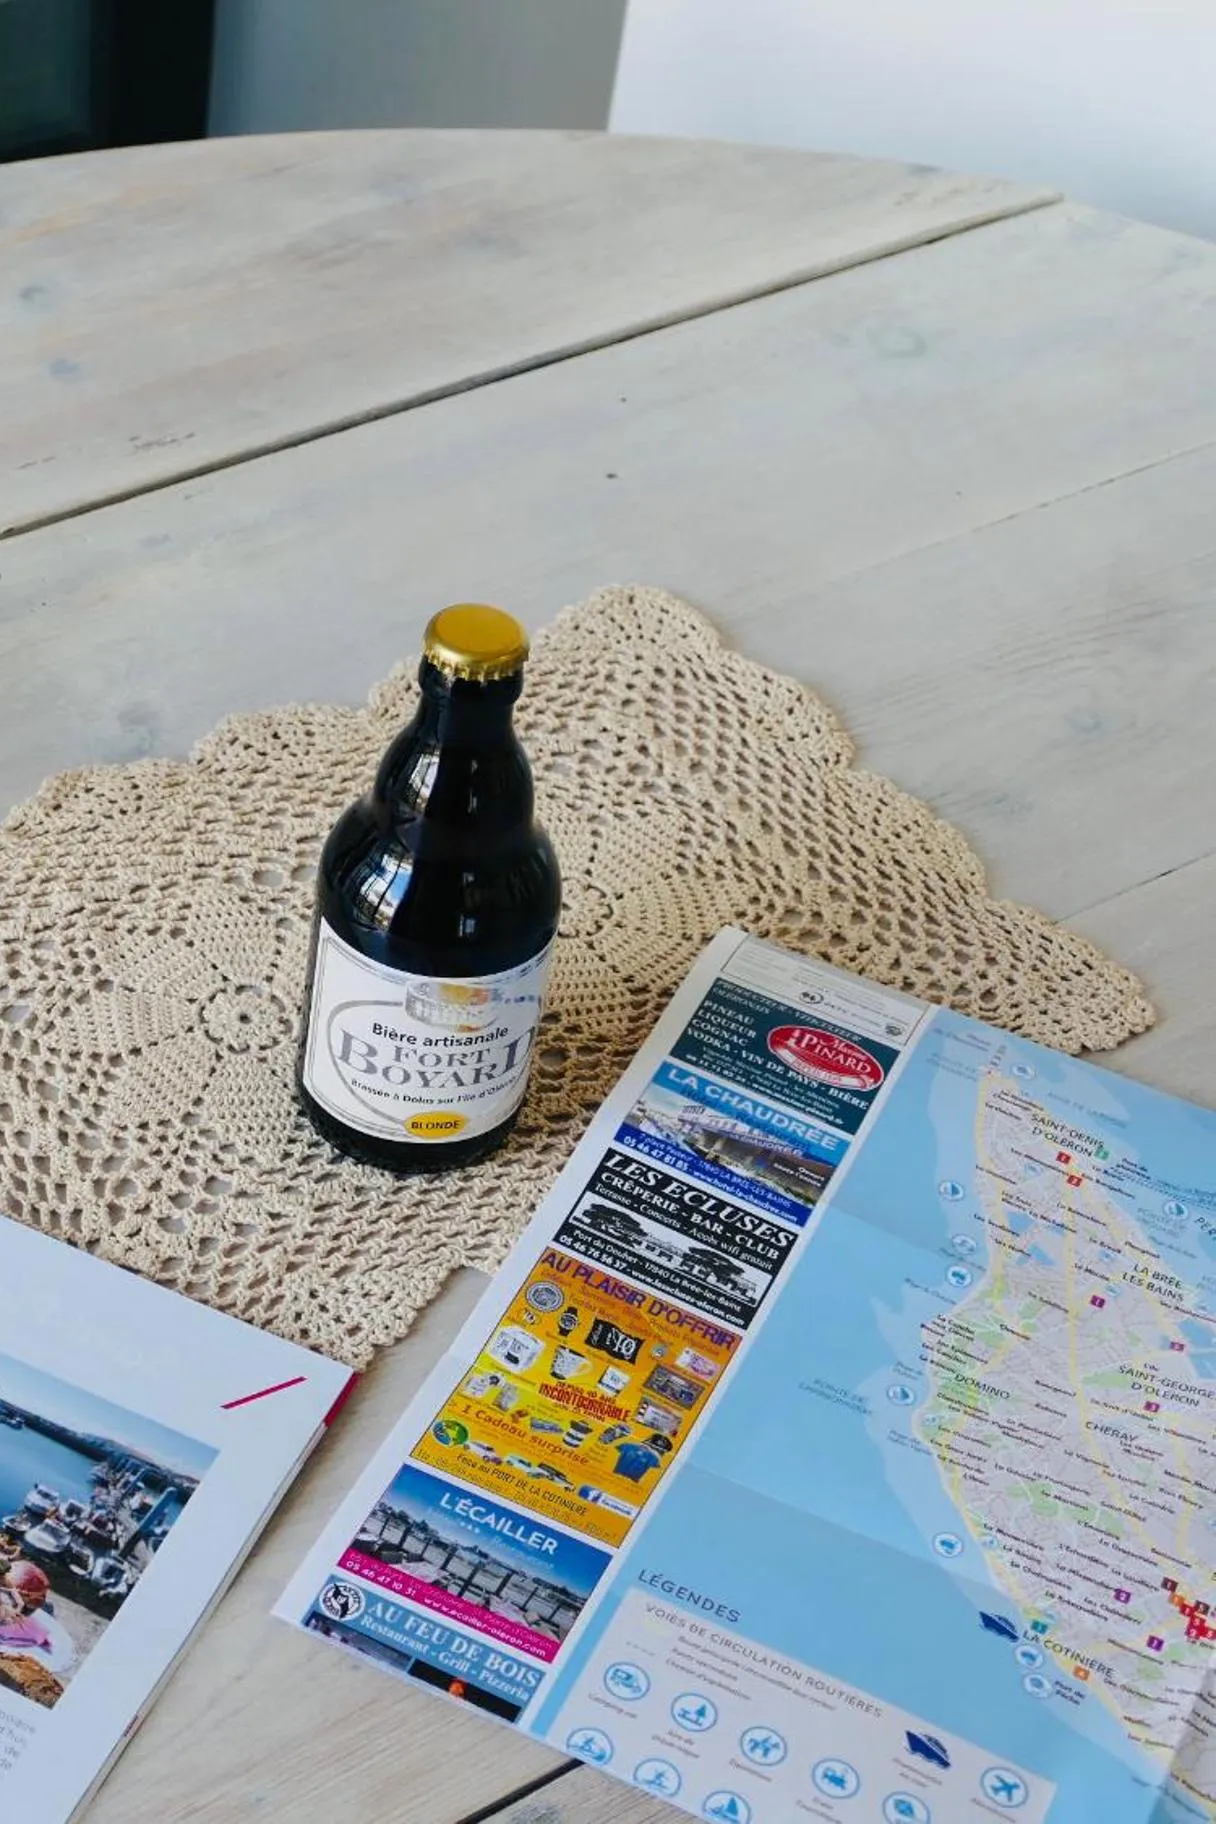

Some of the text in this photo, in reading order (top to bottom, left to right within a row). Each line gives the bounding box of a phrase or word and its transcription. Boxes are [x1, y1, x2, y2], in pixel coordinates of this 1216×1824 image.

[696, 1007, 757, 1040] LIQUEUR
[702, 997, 755, 1026] PINEAU
[371, 1022, 510, 1048] Bière artisanale
[690, 1016, 749, 1047] COGNAC
[393, 1045, 491, 1069] FORT
[684, 1026, 731, 1051] VODKA
[739, 1049, 763, 1065] VIN
[765, 1060, 785, 1074] DE
[786, 1069, 819, 1089] PAYS
[799, 1032, 875, 1076] PINARD
[410, 1119, 461, 1130] BLONDE
[667, 1068, 699, 1093] LA
[708, 1086, 840, 1150] CHAUDRÉE
[622, 1134, 637, 1147] 05
[636, 1141, 650, 1153] 46
[649, 1147, 663, 1159] 47
[599, 1167, 780, 1260] CRÊPERIE BAR CLUB
[603, 1150, 794, 1250] LES ECLUSES
[594, 1182, 632, 1206] Terrasse
[638, 1202, 682, 1229] Concerts
[719, 1240, 740, 1255] wifi
[558, 1234, 573, 1246] 05
[572, 1240, 587, 1253] 46
[572, 1229, 592, 1243] Port
[1122, 1272, 1184, 1302] LES BAINS
[1133, 1263, 1183, 1289] LA BRÉE
[540, 1248, 571, 1275] AU
[570, 1262, 647, 1310] PLAISIR
[646, 1298, 736, 1350] D'OFFRIR
[954, 1373, 1011, 1400] DOMINO
[475, 1407, 528, 1439] Cadeau
[531, 1435, 590, 1466] surprise
[490, 1466, 515, 1485] PORT
[439, 1491, 559, 1556] L'ÉCAILLER
[360, 1566, 376, 1578] 46
[638, 1568, 742, 1625] LÉGENDES
[366, 1596, 403, 1626] AU
[402, 1613, 451, 1649] FEU
[448, 1634, 484, 1663] DE
[483, 1649, 542, 1689] BOIS
[1023, 1629, 1041, 1643] LA
[359, 1613, 531, 1702] Restaurant Grill Pizzeria
[645, 1604, 687, 1627] VOIES
[688, 1622, 706, 1637] DE
[709, 1632, 803, 1681] CIRCULATION
[805, 1674, 883, 1720] ROUTIÈRES
